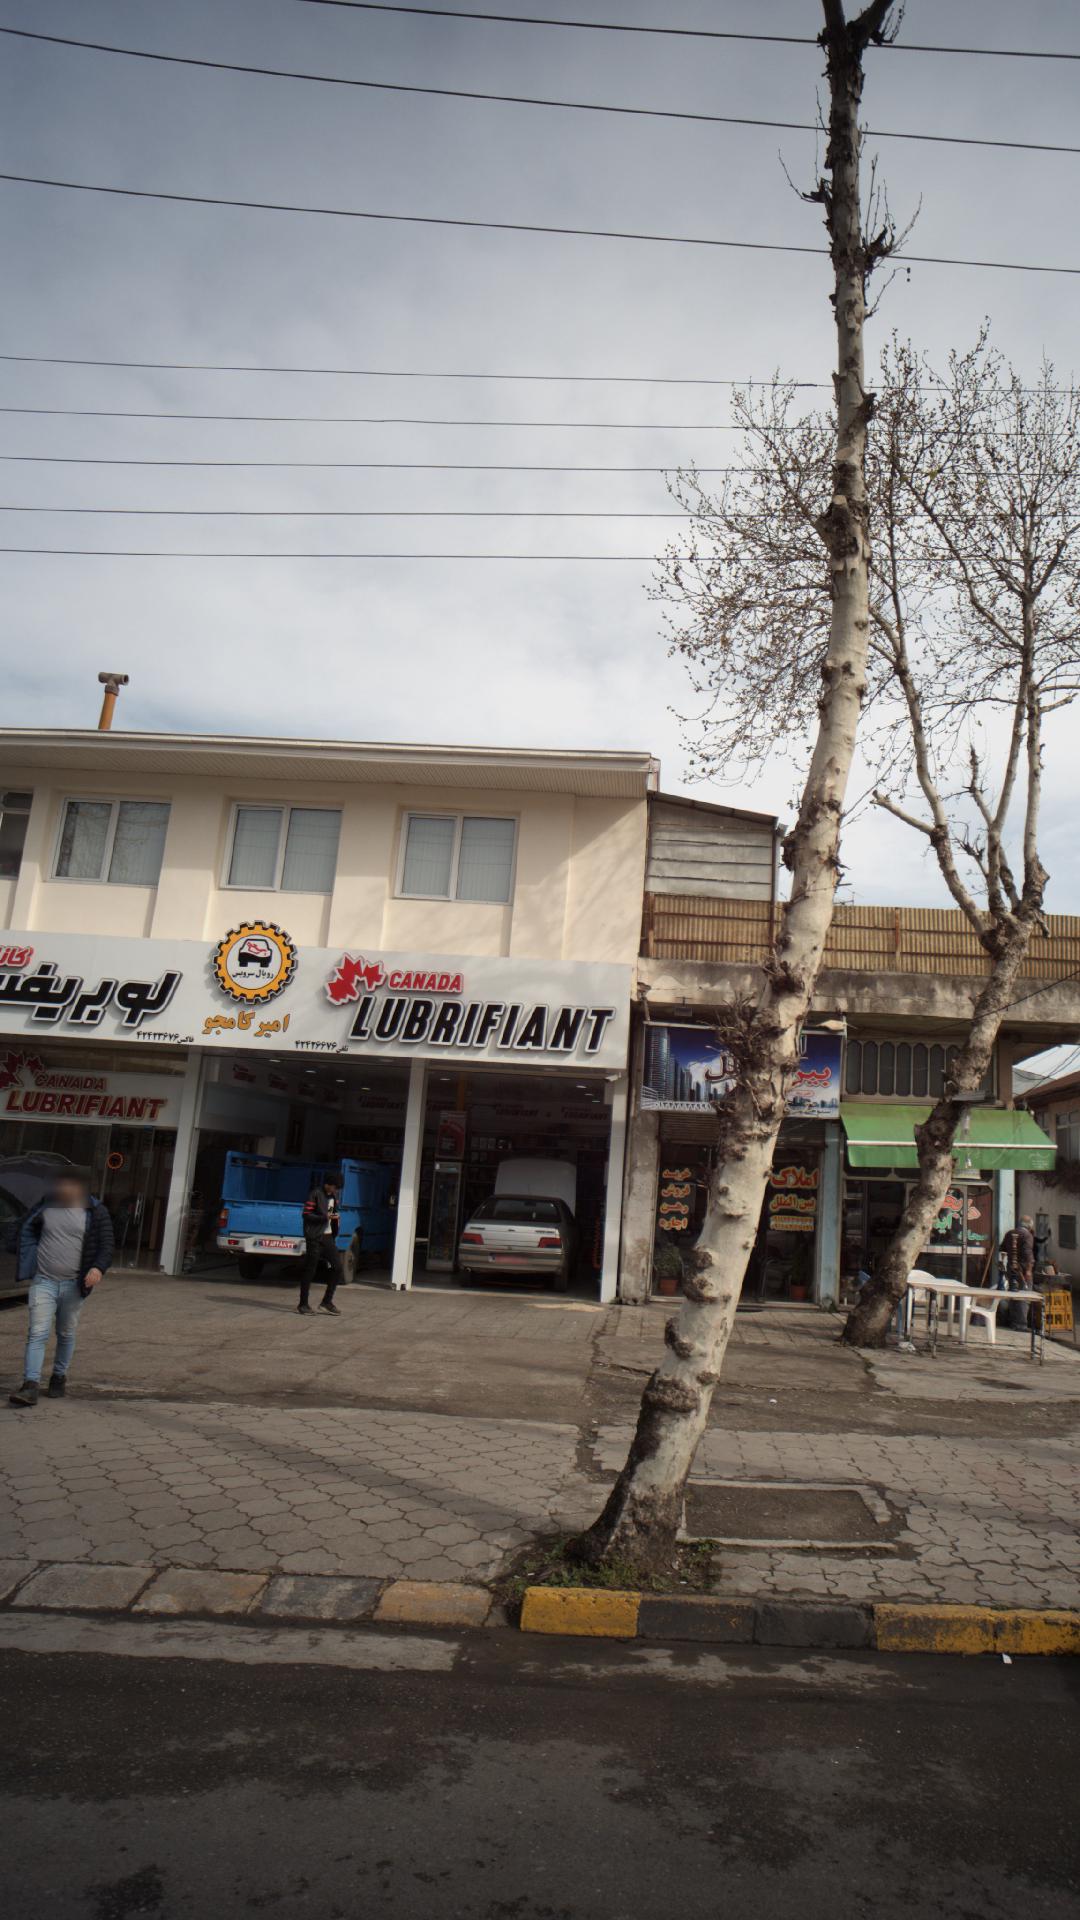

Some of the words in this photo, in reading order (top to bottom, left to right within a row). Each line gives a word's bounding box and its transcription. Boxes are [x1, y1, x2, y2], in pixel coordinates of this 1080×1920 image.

[388, 970, 463, 993] CANADA
[254, 1013, 290, 1038] امیر
[350, 995, 615, 1053] LUBRIFIANT
[35, 1071, 107, 1092] CANADA
[5, 1090, 166, 1121] LUBRIFIANT
[662, 1168, 692, 1181] خرید
[769, 1167, 819, 1188] املاک
[661, 1184, 690, 1198] فروش
[660, 1201, 689, 1214] رهن
[658, 1216, 688, 1231] اجاره
